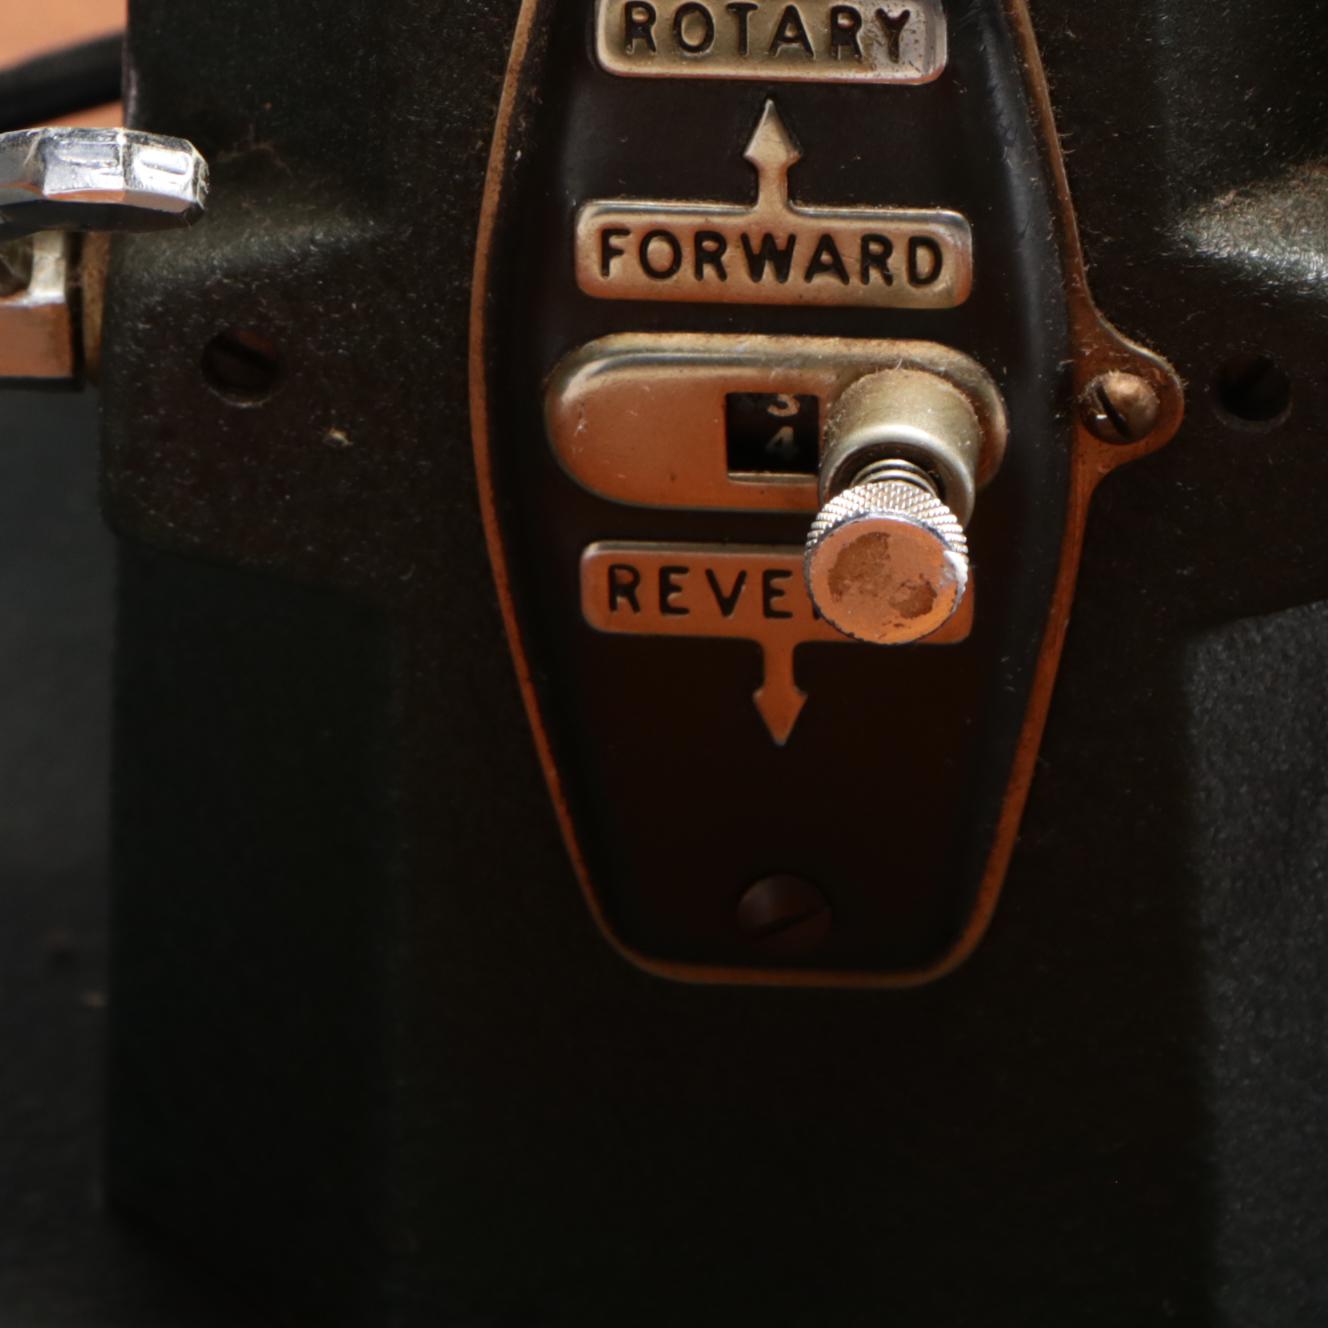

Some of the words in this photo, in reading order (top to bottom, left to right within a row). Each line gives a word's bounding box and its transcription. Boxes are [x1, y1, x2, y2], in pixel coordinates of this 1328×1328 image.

[623, 0, 912, 63] ROTARY
[599, 228, 944, 287] FORWARD
[765, 426, 800, 462] 4
[607, 563, 821, 621] REVE
